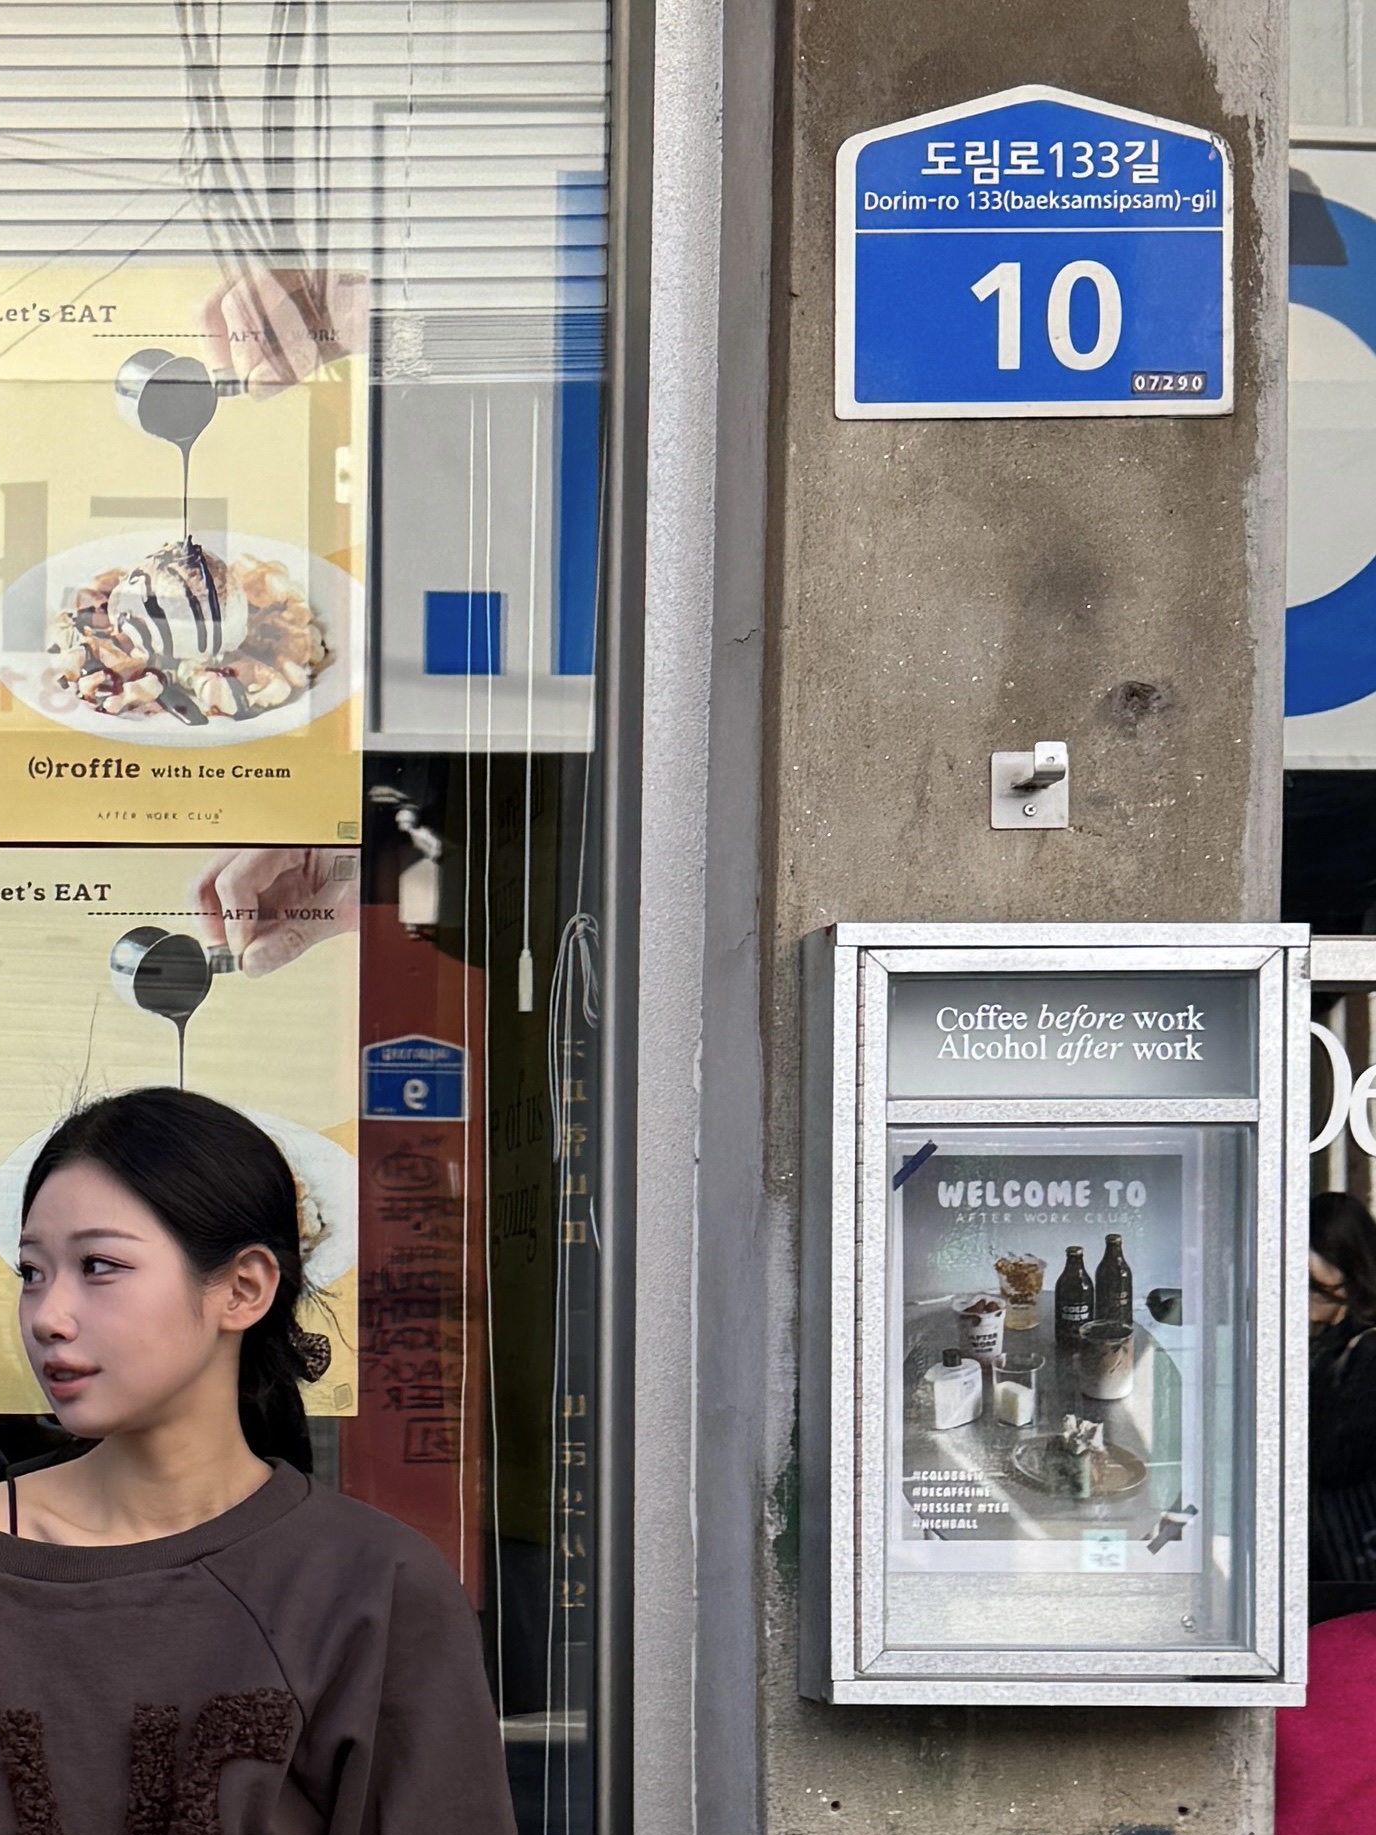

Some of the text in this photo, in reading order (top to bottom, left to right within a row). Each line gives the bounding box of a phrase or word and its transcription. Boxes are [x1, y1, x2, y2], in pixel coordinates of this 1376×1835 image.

[921, 139, 1160, 185] 도림로133길
[864, 190, 1217, 213] Dorim-ro 133(baeksamsipsam)-gil
[59, 305, 116, 322] EAT
[970, 259, 1123, 372] 10
[1134, 374, 1203, 392] 07290
[28, 757, 291, 780] (c)roffle with Ice Cream
[97, 812, 137, 820] AFTER
[146, 812, 178, 820] WORK
[54, 883, 112, 902] EAT
[284, 909, 335, 921] WORK
[936, 1003, 1205, 1037] Coffee before work
[937, 1034, 1204, 1066] Alcohol after work
[938, 1180, 1147, 1208] WELCOME TO
[955, 1213, 1012, 1224] AFTER
[1025, 1213, 1071, 1224] WORK
[913, 1502, 1010, 1513] #DESSERT #TEA
